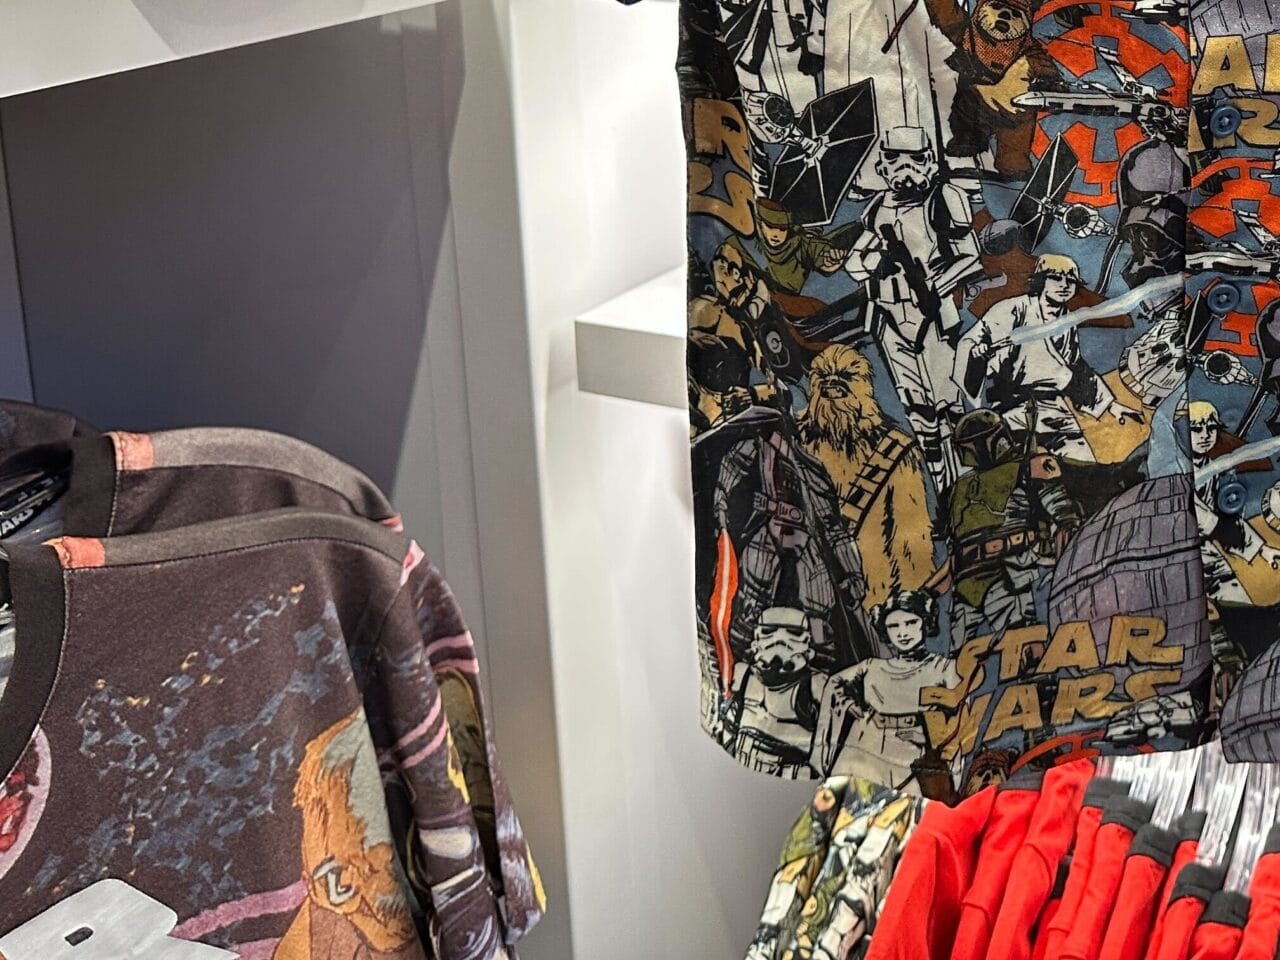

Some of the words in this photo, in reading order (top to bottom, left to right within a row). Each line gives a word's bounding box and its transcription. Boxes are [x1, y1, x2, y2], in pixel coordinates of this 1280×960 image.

[0, 508, 35, 537] ARS
[919, 615, 1185, 708] STAR
[922, 668, 1183, 761] WARS
